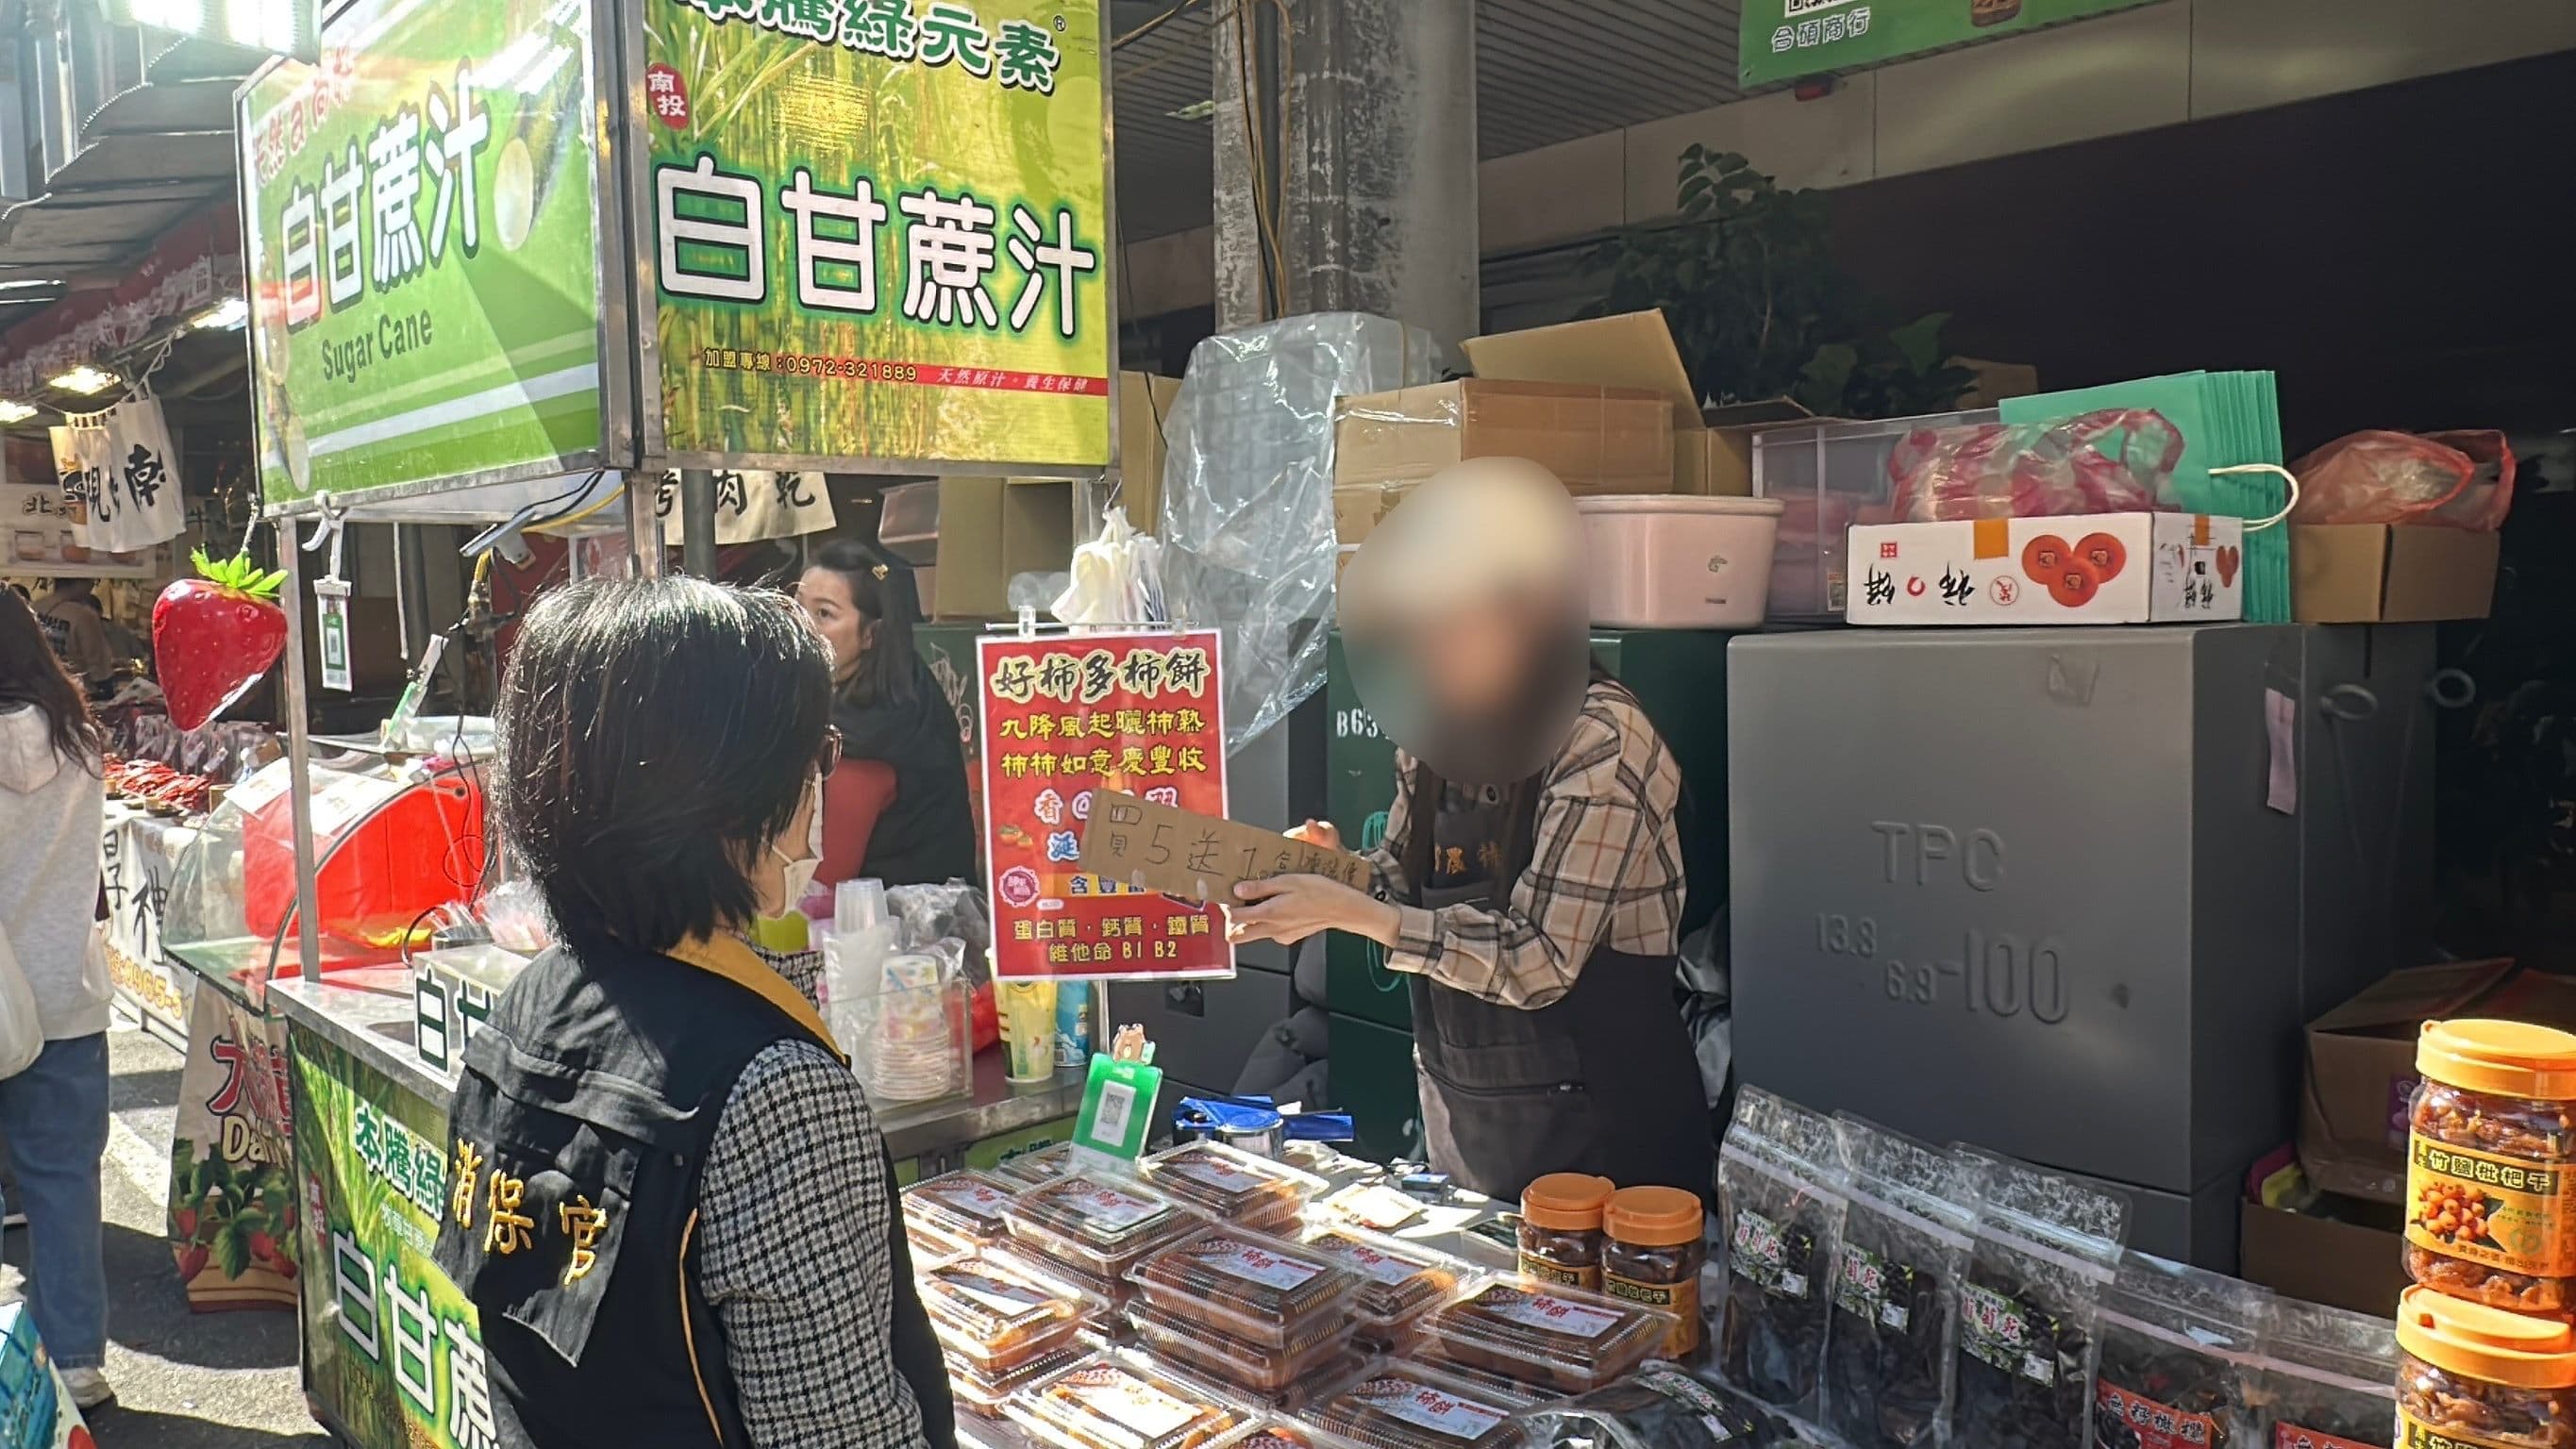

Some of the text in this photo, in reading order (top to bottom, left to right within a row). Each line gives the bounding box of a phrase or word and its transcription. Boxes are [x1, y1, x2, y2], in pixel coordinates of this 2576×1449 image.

[1772, 7, 1870, 53] 合碩商行
[646, 71, 689, 119] 南投
[282, 60, 490, 332] 白甘蔗汁
[657, 156, 1096, 336] 白甘蔗汁
[322, 308, 433, 382] Sugar Cane
[993, 649, 1209, 702] 好柿多柿餅
[1000, 709, 1205, 741] 九降風起曬柿熟
[1001, 744, 1207, 778] 柿柿如意慶豐收
[1871, 820, 2005, 892] TPC
[1013, 919, 1077, 940] 蛋白質
[1102, 917, 1143, 937] 鈣質
[1048, 941, 1178, 963] 維他命 B1 B2
[453, 1138, 609, 1287] 消保官
[333, 1230, 500, 1449] 白甘蔗
